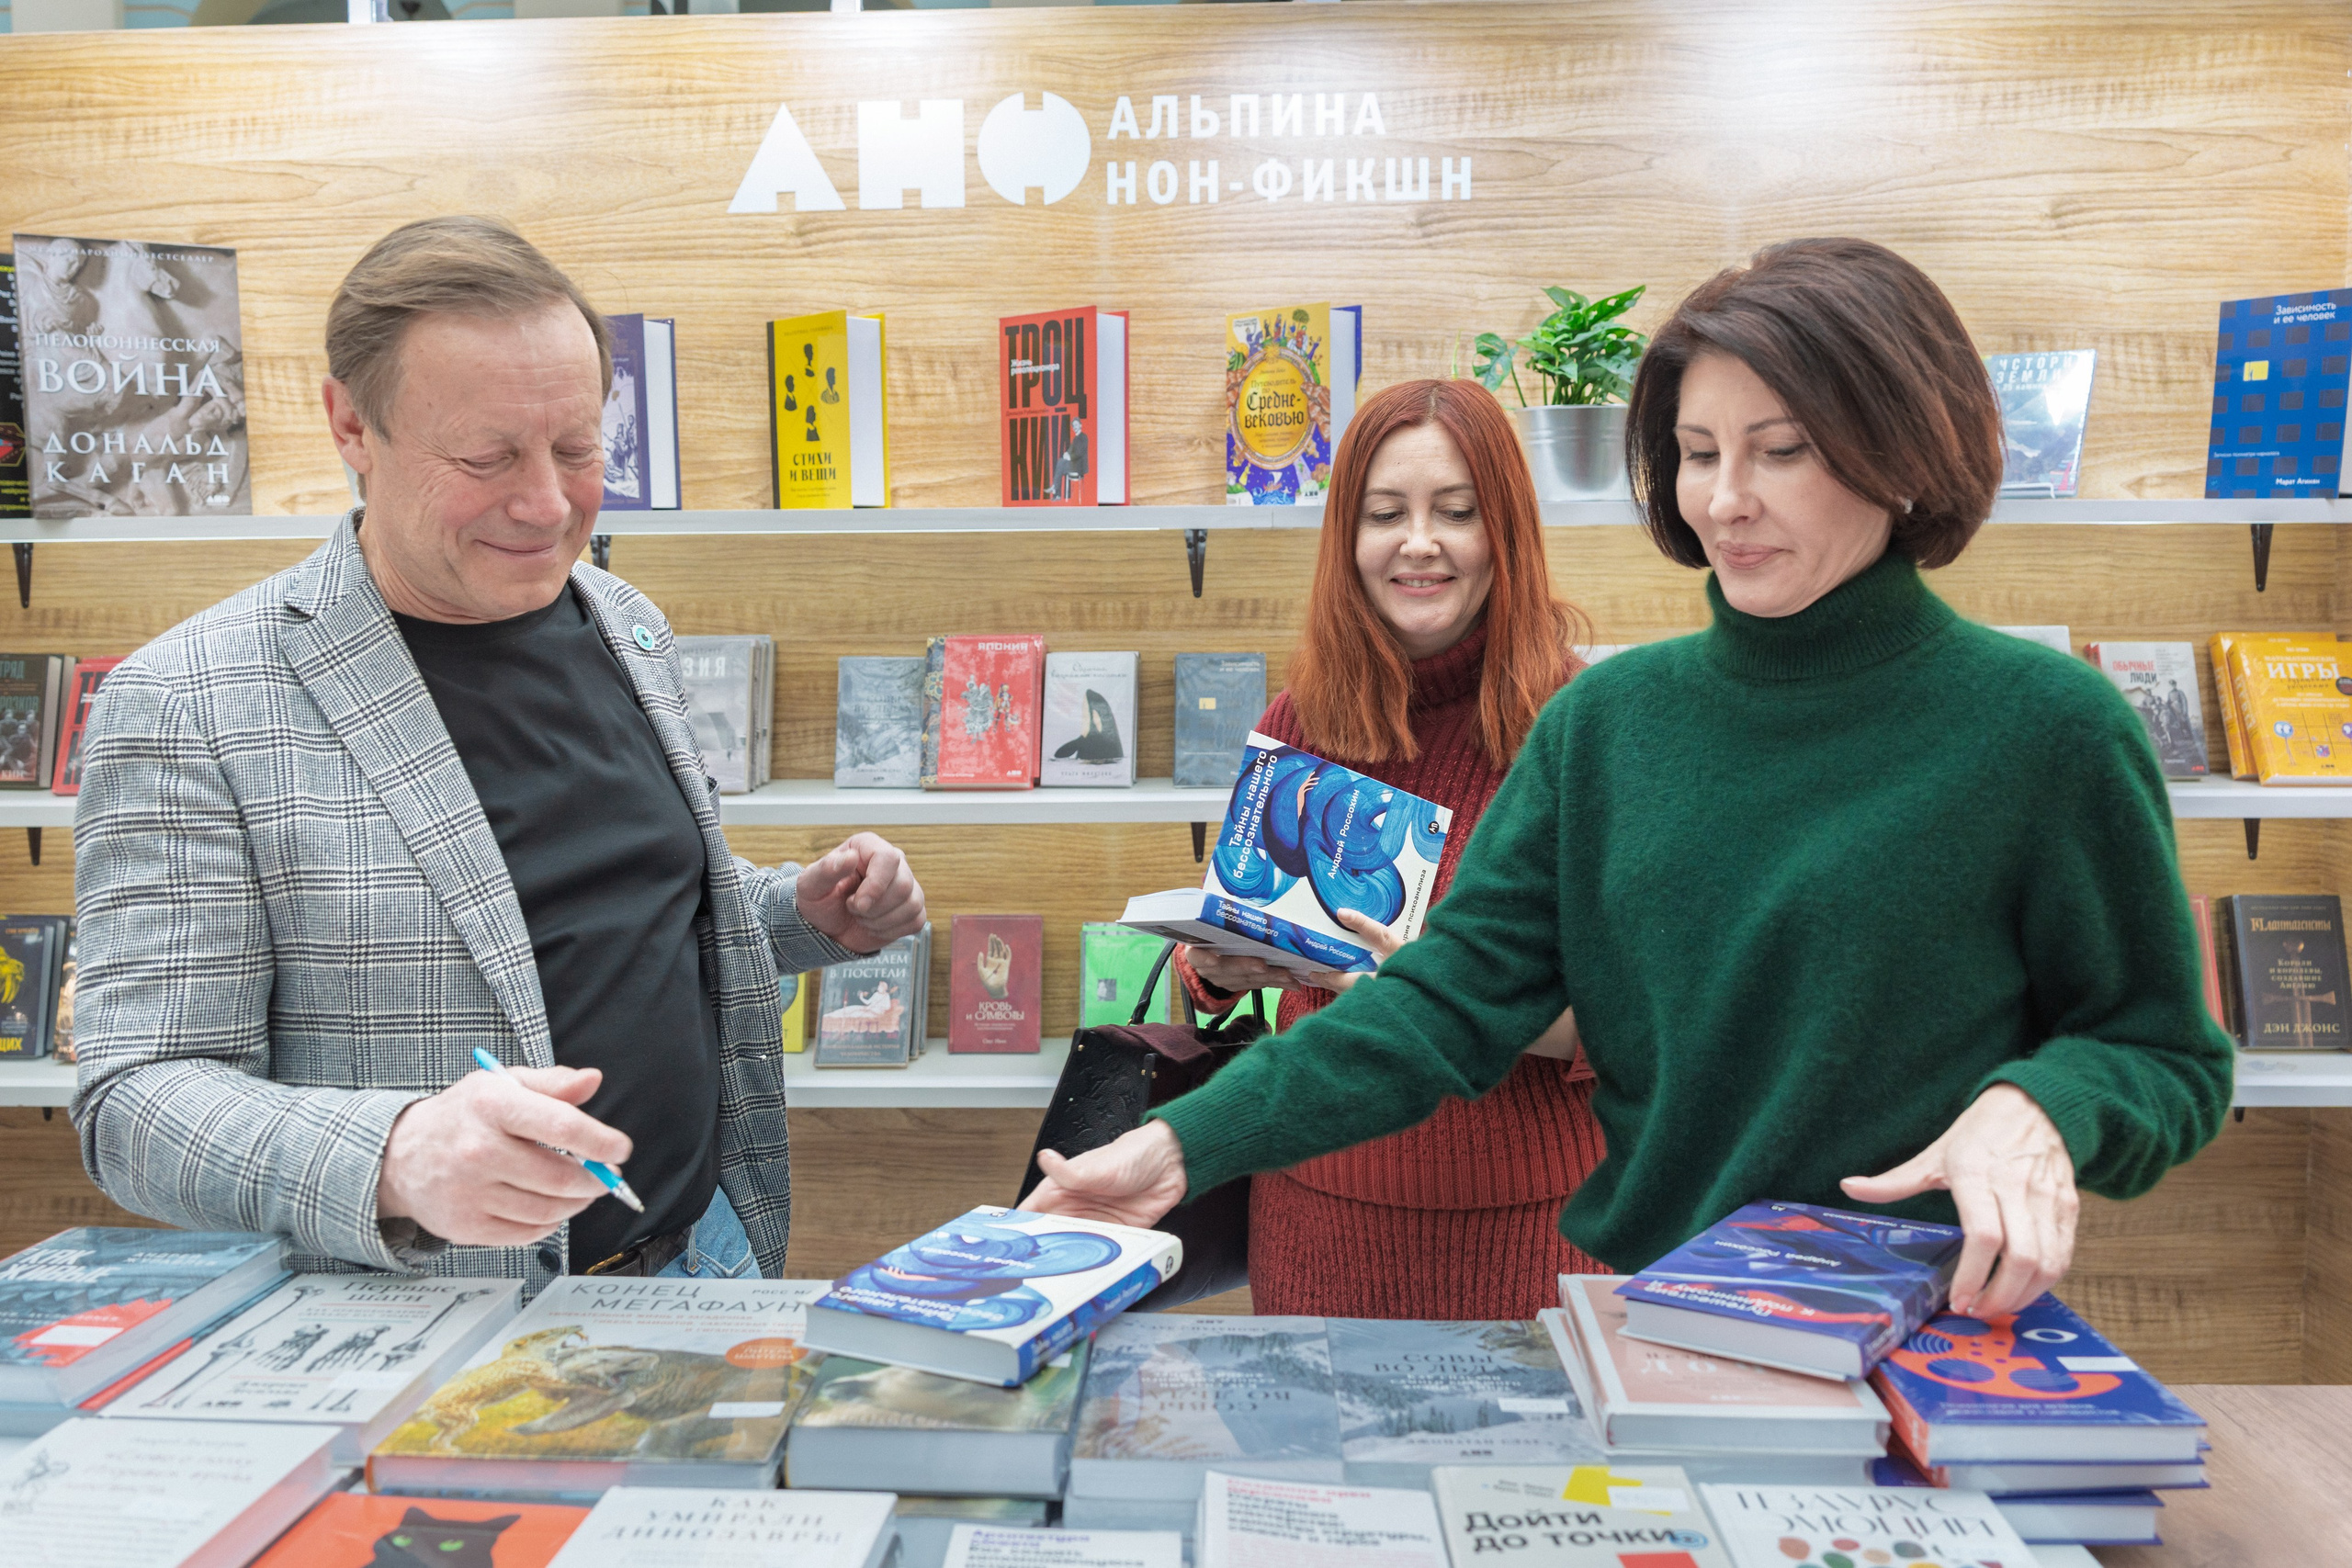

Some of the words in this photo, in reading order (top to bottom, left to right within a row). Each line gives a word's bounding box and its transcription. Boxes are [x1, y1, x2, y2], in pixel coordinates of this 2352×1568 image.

[1107, 92, 1386, 140] АЛЬПИНА
[1106, 155, 1473, 205] НОН-ФИКШН
[143, 252, 215, 264] БЕСТСЕЛЛЕР
[2275, 301, 2336, 315] Зависимость
[2282, 315, 2295, 323] ее
[2296, 311, 2335, 321] человек
[34, 333, 220, 355] ПЕЛОПОННЕССКАЯ
[38, 352, 229, 398] ВОЙНА
[1005, 317, 1087, 419] ТРОЦ
[1246, 390, 1301, 413] Средне-
[1244, 410, 1305, 429] вековью
[42, 431, 230, 457] ДОНАЛЬД
[793, 452, 831, 466] СТИХИ
[46, 461, 230, 484] КАГАН
[790, 469, 797, 481] И
[801, 468, 836, 481] ВЕЩИ
[978, 642, 1028, 650] ЯПОНИЯ
[2112, 660, 2154, 671] ОБЫЧНЫЕ
[2266, 662, 2340, 680] ИГРЫ
[2130, 672, 2157, 684] ЛЮДИ
[1228, 807, 1250, 847] Тайны
[1246, 750, 1267, 801] нашего
[1233, 755, 1278, 879] бессознательного
[1328, 840, 1345, 879] Андрей
[1340, 789, 1360, 838] Россохин
[1408, 869, 1427, 921] психоанализа
[1218, 900, 1239, 915] Тайны
[1241, 910, 1268, 925] нашего
[1216, 909, 1279, 937] бессознательного
[2250, 917, 2332, 931] Плантагенеты
[1305, 938, 1328, 951] Андрей
[1328, 946, 1356, 961] Россохин
[830, 968, 837, 978] В
[843, 968, 906, 978] ПОСТЕЛИ
[978, 1001, 1012, 1012] КРОВЬ
[975, 1011, 1024, 1021] СИМВОЛЫ
[2263, 1022, 2290, 1033] ДЭН
[2293, 1022, 2341, 1033] ДЖОНС
[18, 1249, 96, 1266] КАК
[1714, 1240, 1781, 1258] Россохин
[1785, 1253, 1841, 1268] Андрей
[0, 1263, 121, 1283] ЖИВЫЕ
[342, 1280, 457, 1294] Первые
[571, 1283, 702, 1299] КОНЕЦ
[346, 1293, 425, 1303] шаги
[591, 1298, 803, 1313] МЕГАФАУН
[1671, 1282, 1793, 1313] подлинному
[1403, 1353, 1493, 1364] СОВЫ
[1374, 1363, 1416, 1372] ВО
[1430, 1363, 1530, 1374] ЛЬДАХ
[711, 1496, 776, 1509] КАК
[649, 1509, 823, 1526] УМИРАЛИ
[1464, 1508, 1603, 1533] Дойти
[600, 1526, 842, 1544] ДИНОЗАВРЫ
[1473, 1534, 1528, 1553] до
[1544, 1528, 1681, 1548] точки
